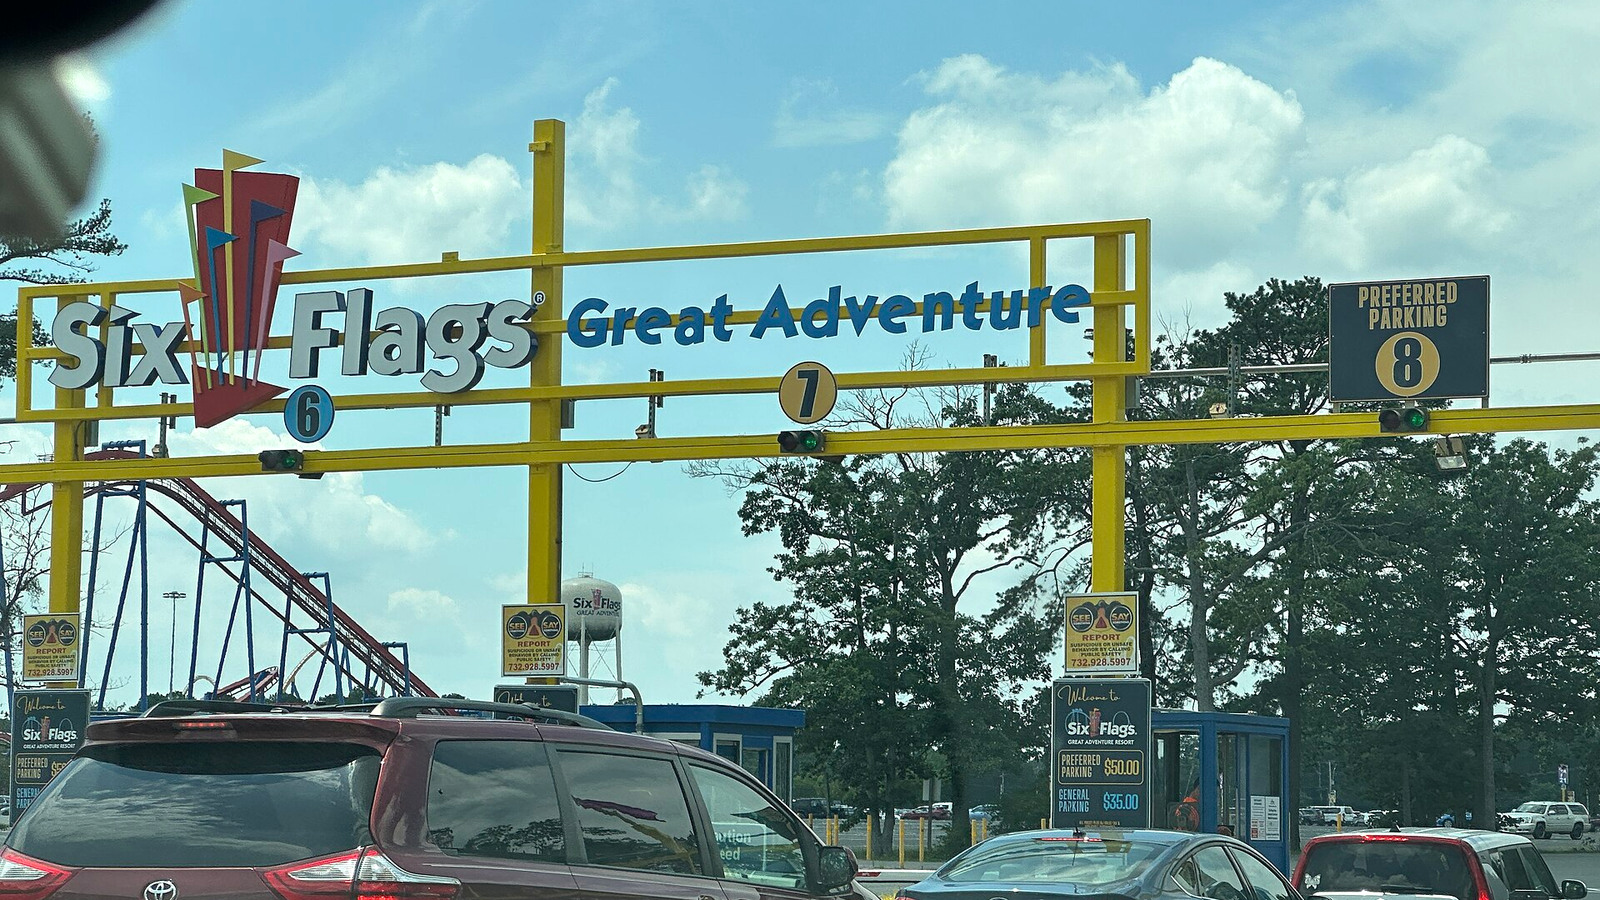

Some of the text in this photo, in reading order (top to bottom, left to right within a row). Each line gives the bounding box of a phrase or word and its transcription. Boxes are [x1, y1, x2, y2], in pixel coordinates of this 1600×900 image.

[1358, 282, 1458, 308] PREFERRED
[1369, 305, 1447, 330] PARKING
[49, 301, 192, 390] Six
[567, 294, 734, 348] Great
[750, 281, 1091, 339] Adventure
[1392, 337, 1423, 389] 8
[797, 369, 819, 418] 7
[298, 391, 320, 438] 6
[573, 598, 592, 608] Six
[1072, 658, 1130, 667] 732.928.5997
[1058, 685, 1120, 706] Welcome to
[23, 728, 40, 740] Six
[1068, 722, 1089, 736] Six
[18, 758, 48, 768] PREFERRED
[1062, 754, 1100, 766] PREFERRED
[1104, 758, 1140, 776] $50.00
[17, 769, 41, 778] PARKING
[1062, 766, 1092, 778] PARKING
[1058, 788, 1089, 800] GENERAL
[1058, 800, 1089, 812] PARKING
[1104, 792, 1138, 811] $35.00
